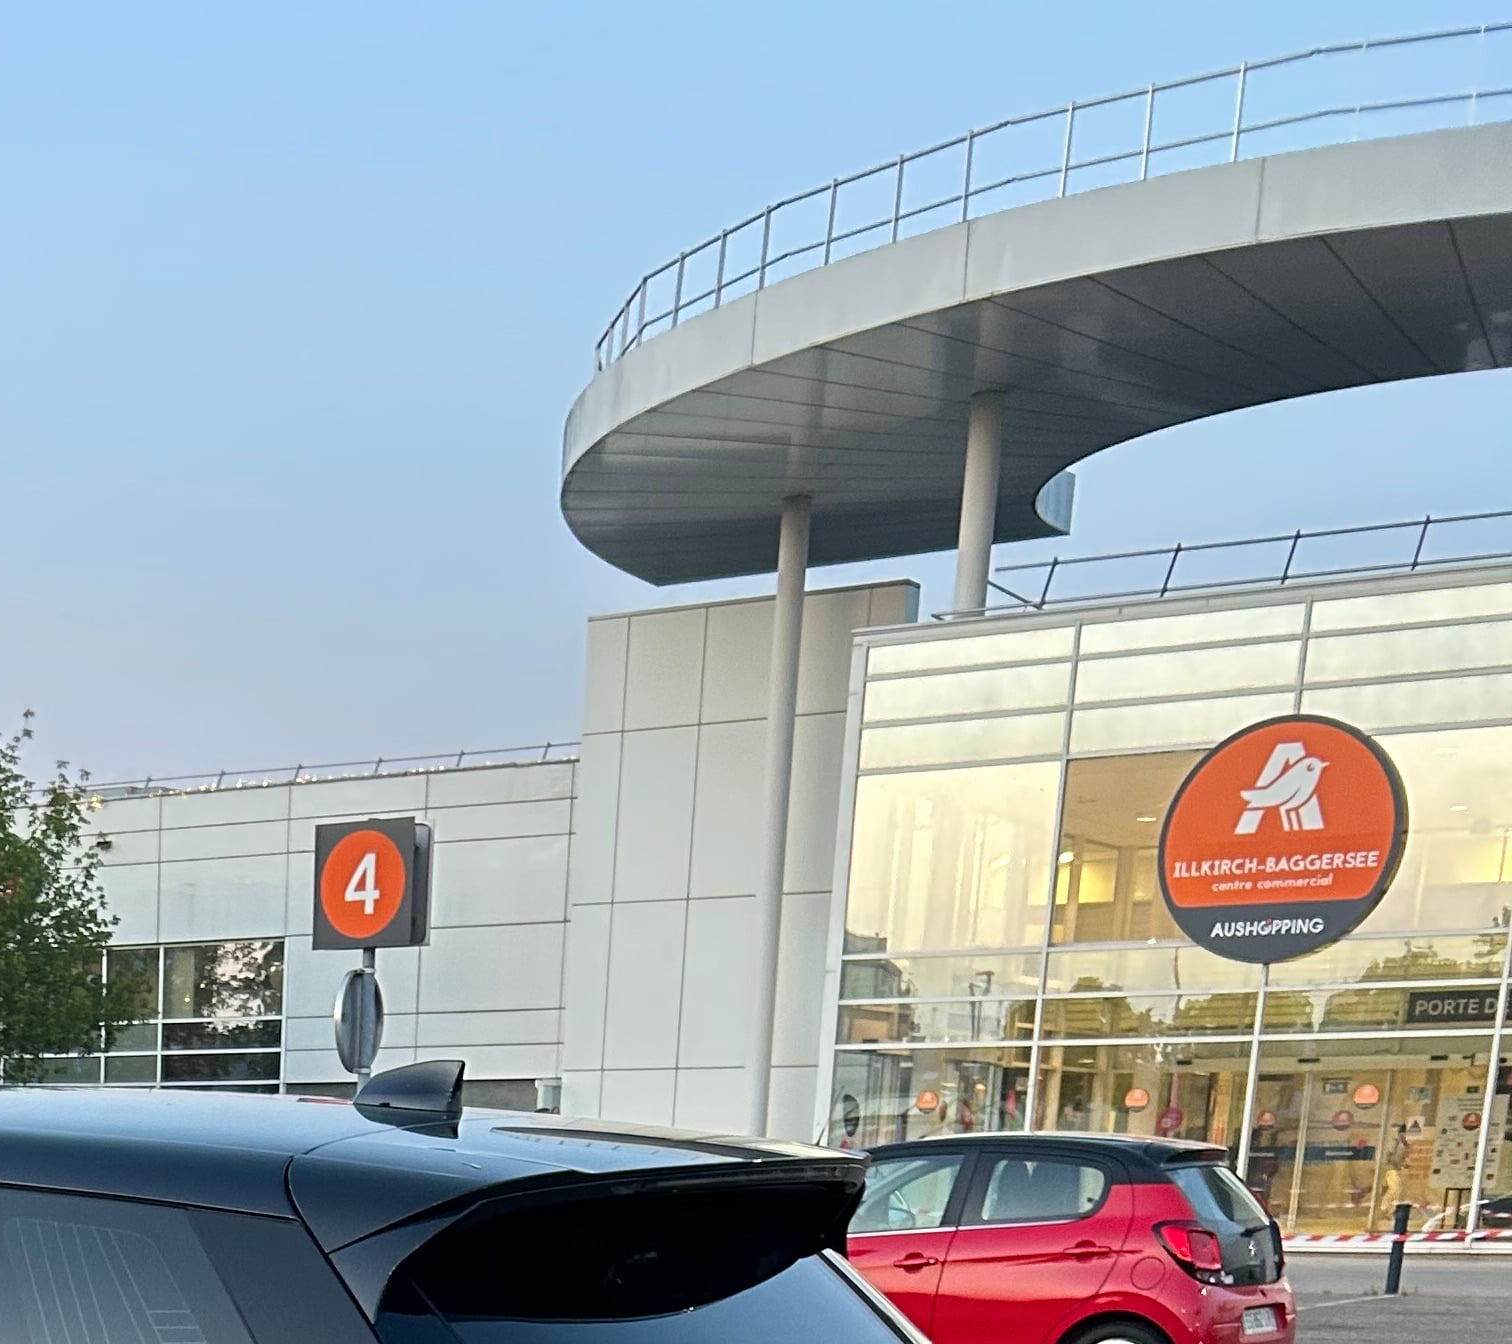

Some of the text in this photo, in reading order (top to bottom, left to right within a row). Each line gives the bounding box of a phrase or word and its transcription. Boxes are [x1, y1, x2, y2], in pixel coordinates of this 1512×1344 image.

[1173, 851, 1380, 879] ILLKIRCH-BAGGERSEE
[344, 852, 381, 915] 4
[1211, 873, 1333, 892] centre commercial
[1415, 997, 1509, 1016] PORTE D
